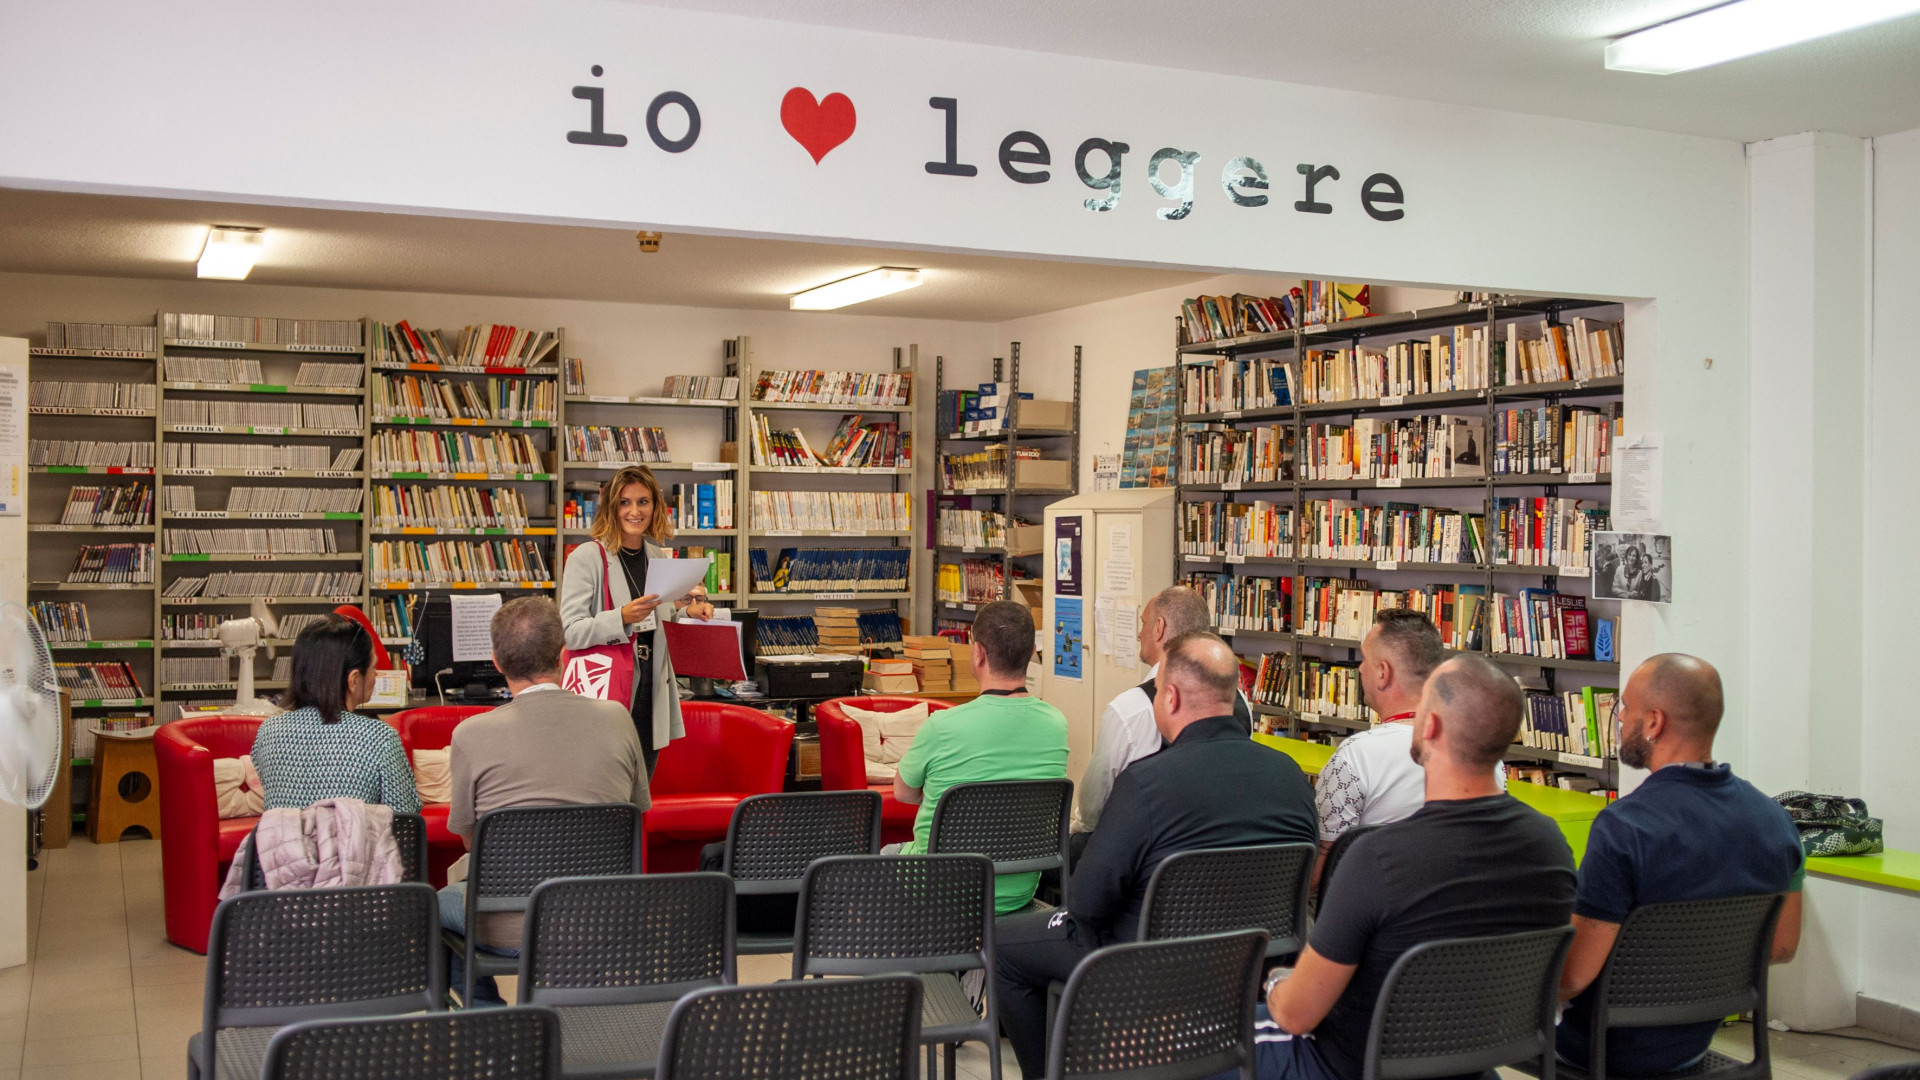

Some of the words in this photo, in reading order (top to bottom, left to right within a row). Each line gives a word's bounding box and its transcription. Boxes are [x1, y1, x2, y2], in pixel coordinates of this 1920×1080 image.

[566, 65, 702, 154] io
[924, 97, 1406, 223] leggere
[29, 348, 75, 356] ANTAUTORI
[93, 350, 145, 358] CANTAUTORI
[1337, 579, 1368, 590] WILLIAM
[1556, 596, 1584, 607] LESLIE
